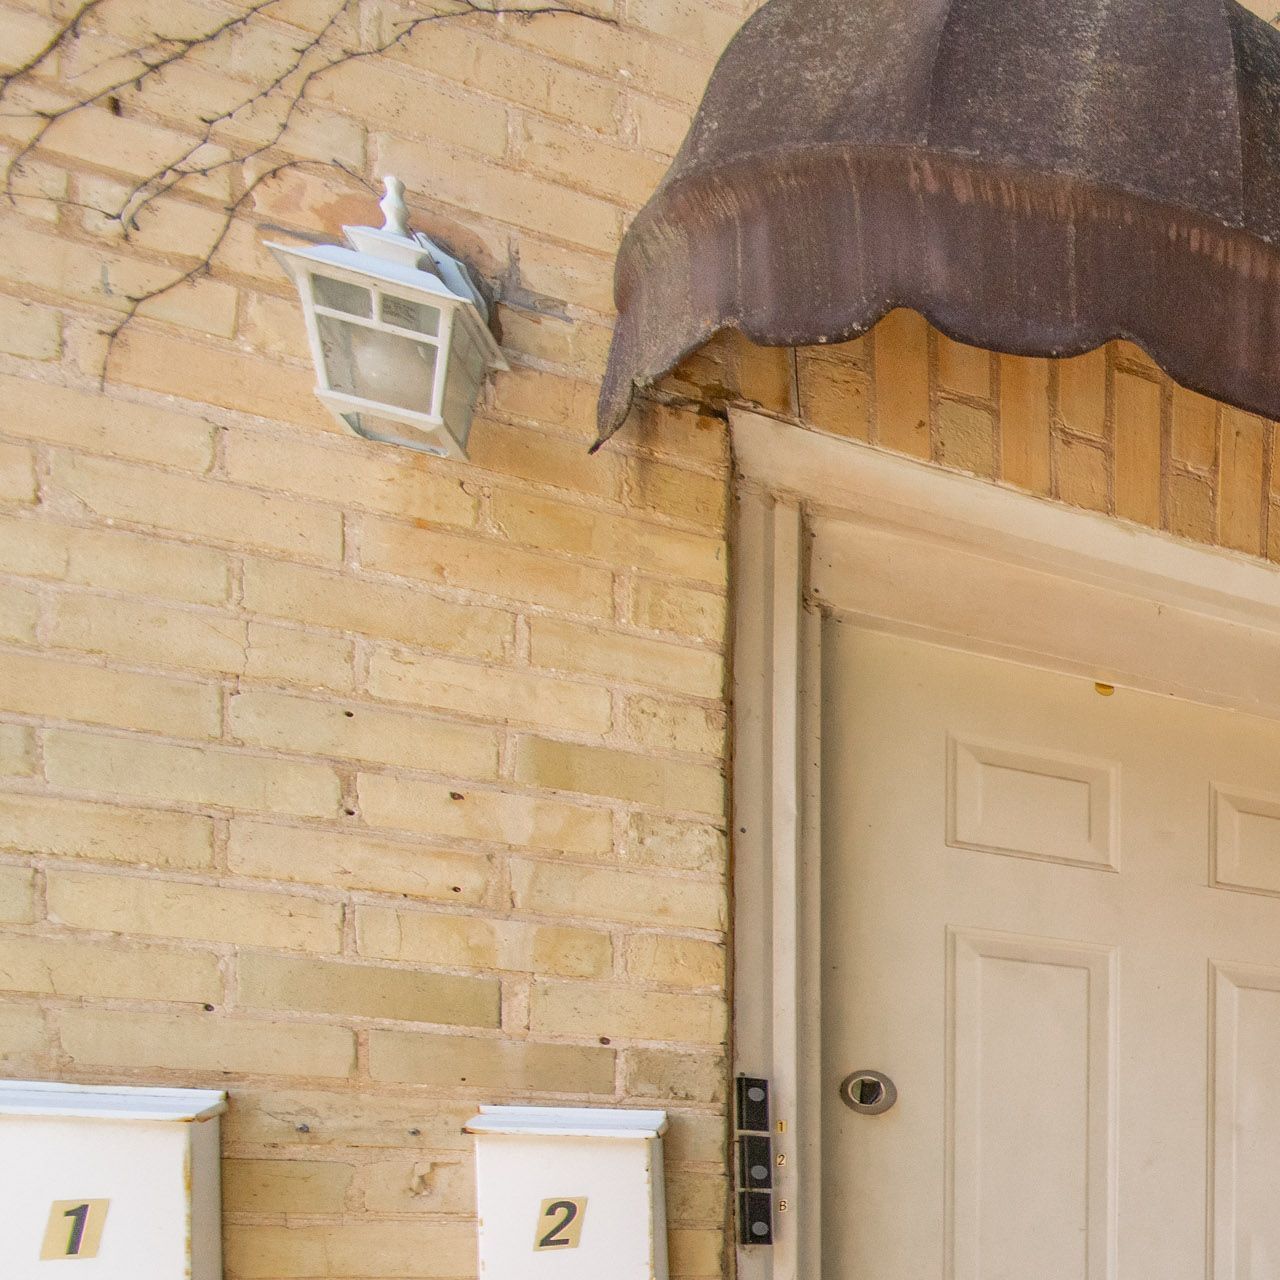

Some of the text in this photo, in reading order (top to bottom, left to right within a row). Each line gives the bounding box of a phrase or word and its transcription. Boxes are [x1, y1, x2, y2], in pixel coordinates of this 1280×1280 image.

[778, 1122, 784, 1132] 1
[777, 1154, 786, 1166] 2
[779, 1200, 787, 1212] B
[64, 1204, 89, 1255] 1
[540, 1200, 577, 1247] 2
